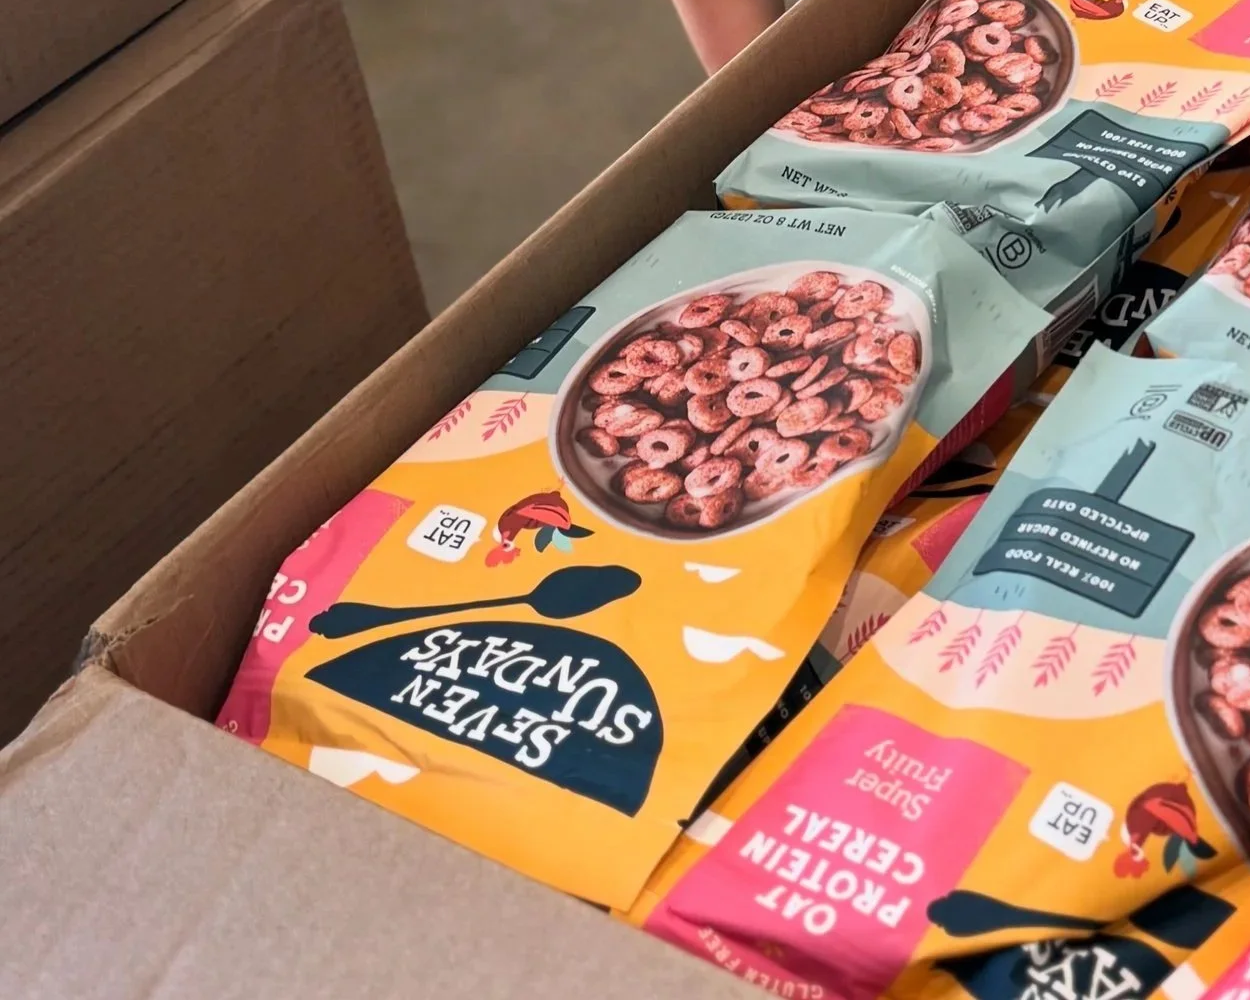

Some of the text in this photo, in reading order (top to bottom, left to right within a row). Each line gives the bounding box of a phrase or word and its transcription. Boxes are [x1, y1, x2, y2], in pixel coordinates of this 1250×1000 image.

[1149, 2, 1183, 21] EAT
[1075, 141, 1093, 151] NO
[1137, 155, 1174, 175] SUGAR
[1100, 129, 1188, 159] 100% REAL FOOD
[781, 165, 812, 188] NET
[1117, 169, 1147, 188] OATS
[754, 214, 774, 225] OZ
[776, 216, 787, 226] 8
[788, 217, 812, 231] WT
[815, 222, 847, 237] NET
[423, 526, 466, 550] EAT
[1042, 498, 1151, 544] UPCYCLED OATS
[1016, 522, 1142, 571] NO REFINED SUGAR
[1004, 548, 1117, 593] 100% REAL FOOD
[399, 628, 653, 745] SUNDAYS
[390, 674, 572, 768] SEVEN
[863, 738, 954, 793] Fruity
[844, 767, 934, 822] Super
[784, 803, 926, 886] CEREAL
[1047, 812, 1093, 845] EAT
[739, 830, 913, 930] PROTEIN
[755, 884, 838, 936] OAT
